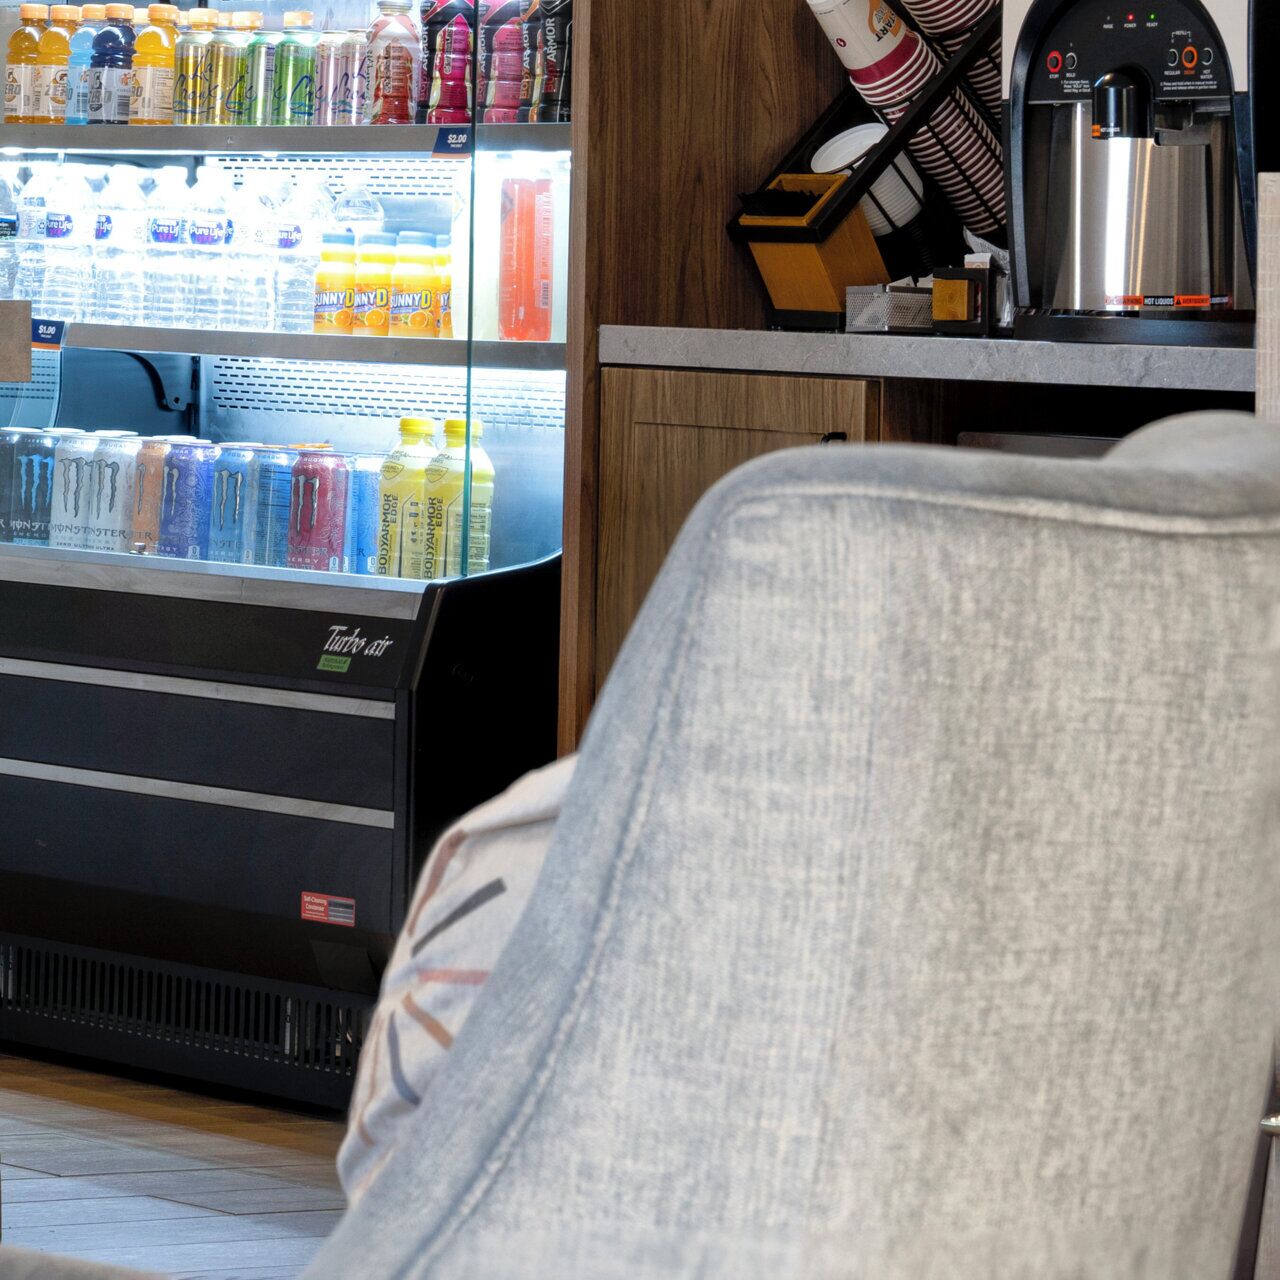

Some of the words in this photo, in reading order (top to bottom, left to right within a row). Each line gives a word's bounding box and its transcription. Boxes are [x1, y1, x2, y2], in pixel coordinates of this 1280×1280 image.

[448, 134, 467, 144] $2.00
[151, 224, 168, 234] Pure
[190, 225, 209, 235] Pure
[209, 227, 224, 239] Life
[38, 325, 56, 335] $1.00
[390, 493, 399, 524] EDGE
[435, 496, 444, 528] EDGE
[88, 525, 128, 539] NSTER
[378, 493, 393, 575] BODYARMOR
[424, 496, 436, 579] BODYARMOR
[323, 625, 367, 654] Turbo
[364, 636, 393, 657] air
